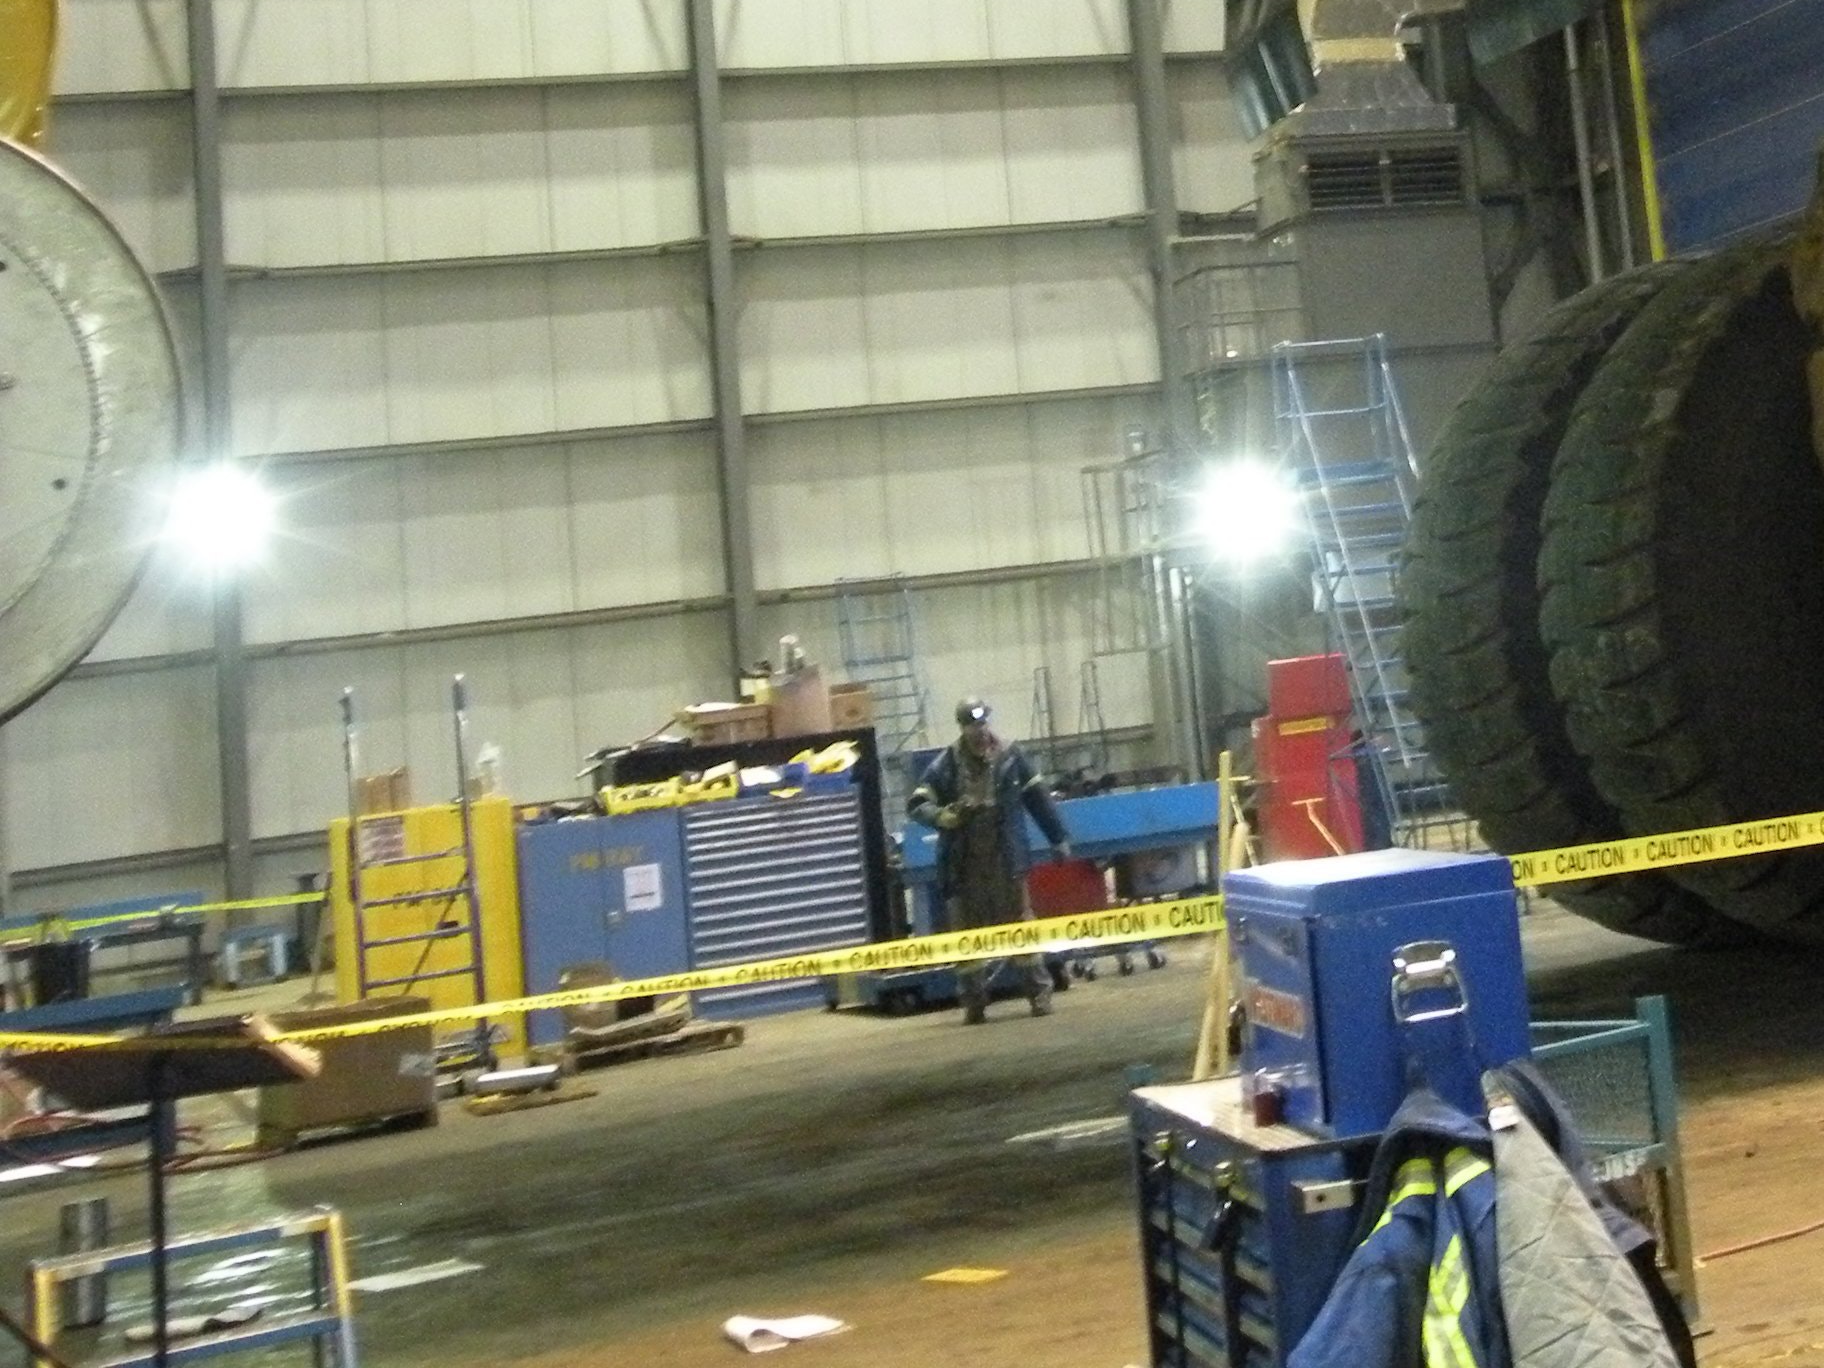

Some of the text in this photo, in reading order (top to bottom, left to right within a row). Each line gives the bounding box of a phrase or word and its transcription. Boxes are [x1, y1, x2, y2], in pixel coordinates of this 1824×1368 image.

[1555, 848, 1624, 874] CAUTION
[1646, 834, 1713, 861] CAUTION
[1733, 822, 1799, 849] CAUTION
[849, 945, 934, 968] CAUTION
[958, 929, 1040, 955] CAUTION
[1066, 913, 1146, 940] CAUTION
[1169, 900, 1225, 928] CAUTI
